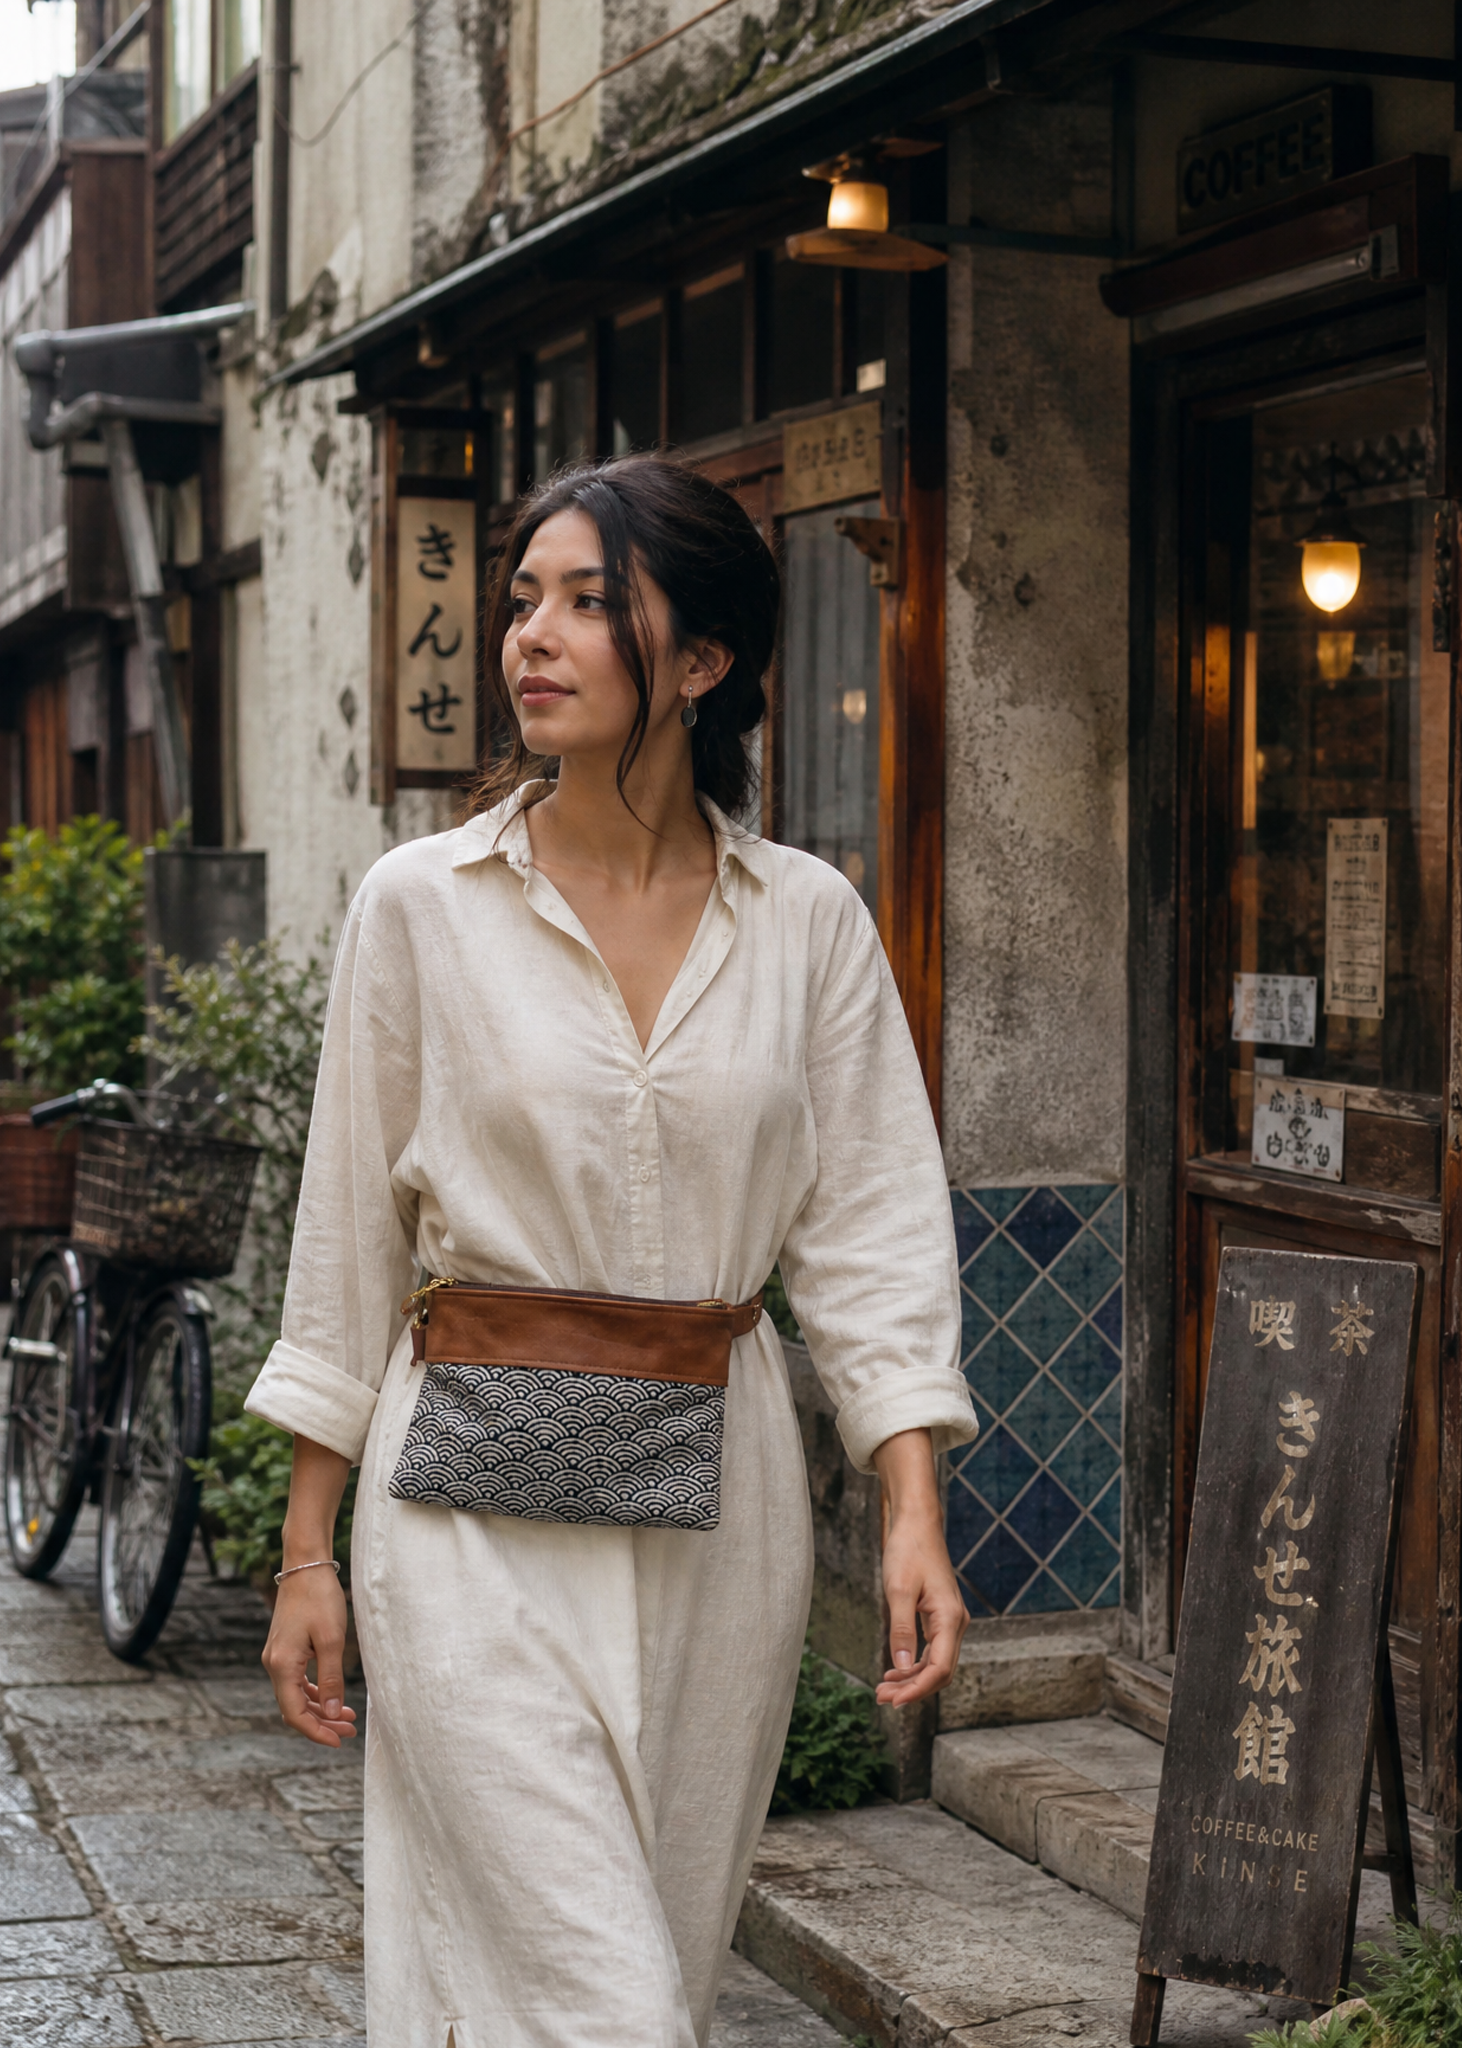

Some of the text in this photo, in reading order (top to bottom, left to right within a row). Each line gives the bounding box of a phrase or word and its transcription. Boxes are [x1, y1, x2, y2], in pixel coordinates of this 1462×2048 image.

[1183, 111, 1325, 209] COFFEE
[408, 523, 463, 735] きんせ
[1232, 1390, 1320, 1786] きんせ旅館
